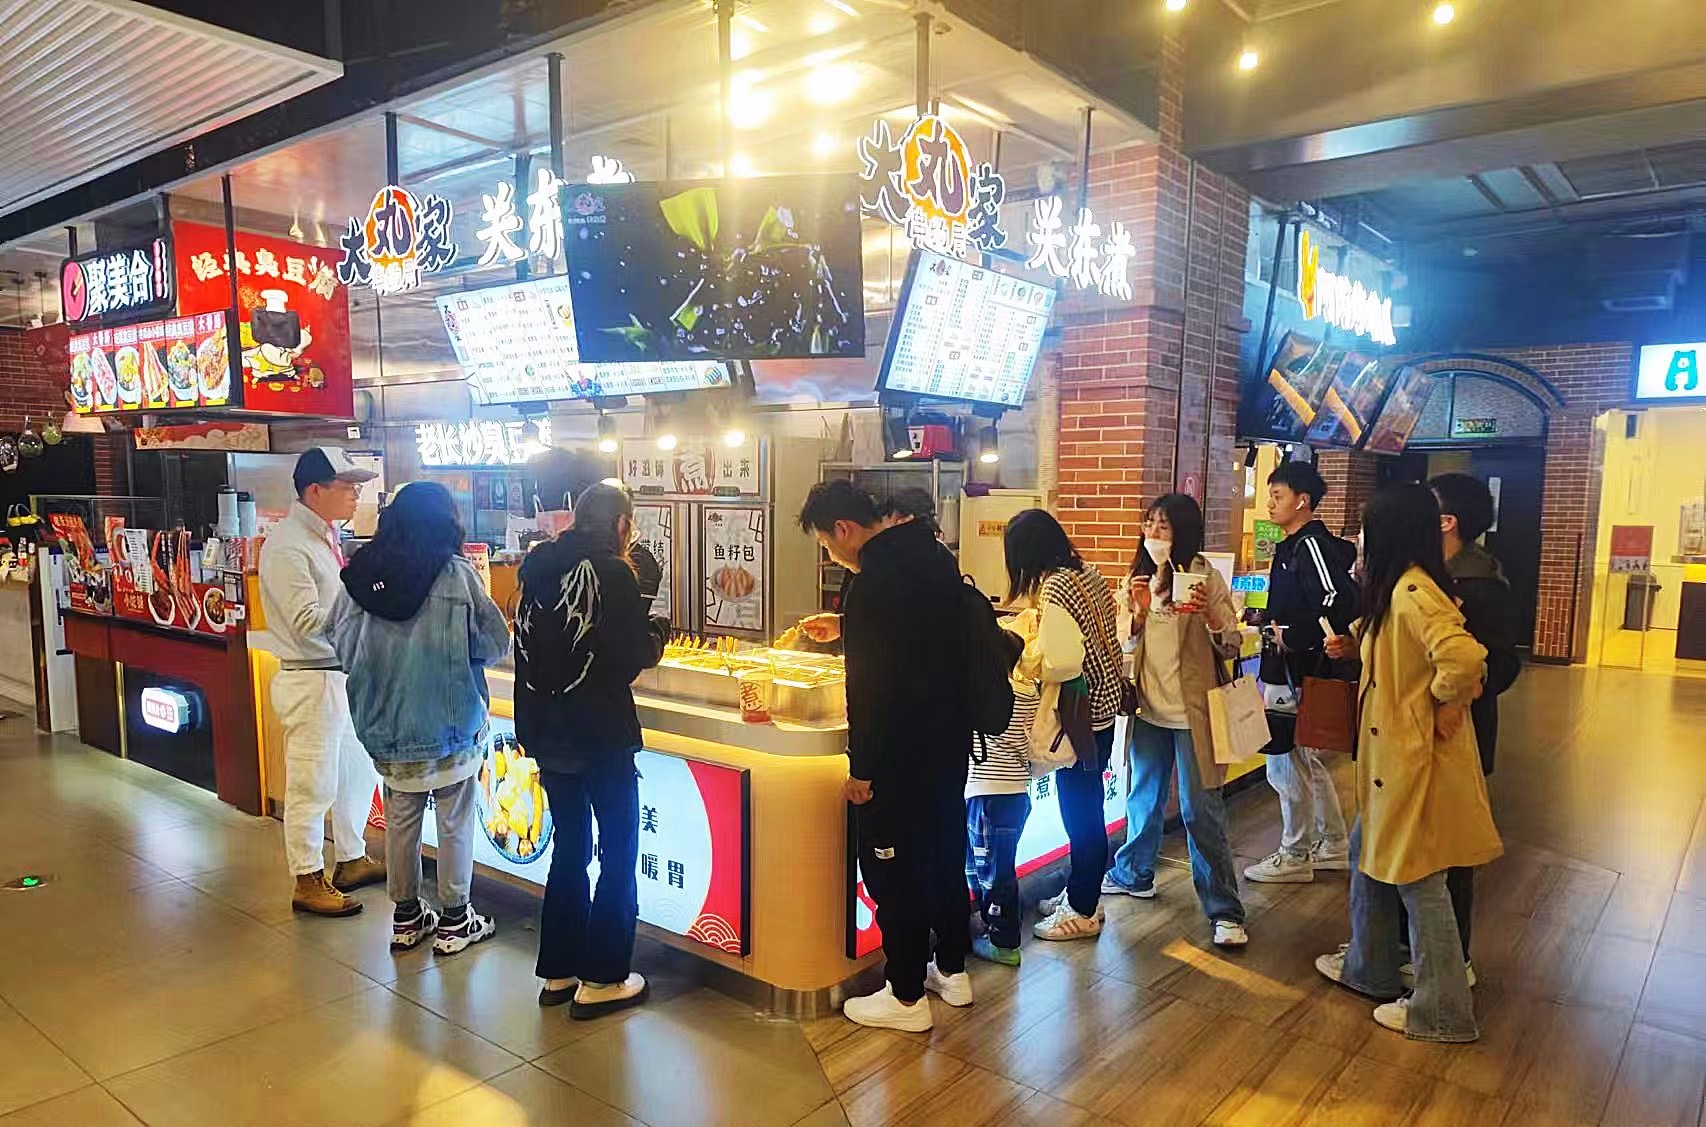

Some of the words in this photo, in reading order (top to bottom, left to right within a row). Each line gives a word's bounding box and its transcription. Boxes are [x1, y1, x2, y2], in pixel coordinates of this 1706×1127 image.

[475, 156, 635, 265] 关东
[1025, 196, 1136, 300] 关东煮
[713, 544, 756, 562] 鱼籽包
[641, 853, 685, 889] 暖胃
